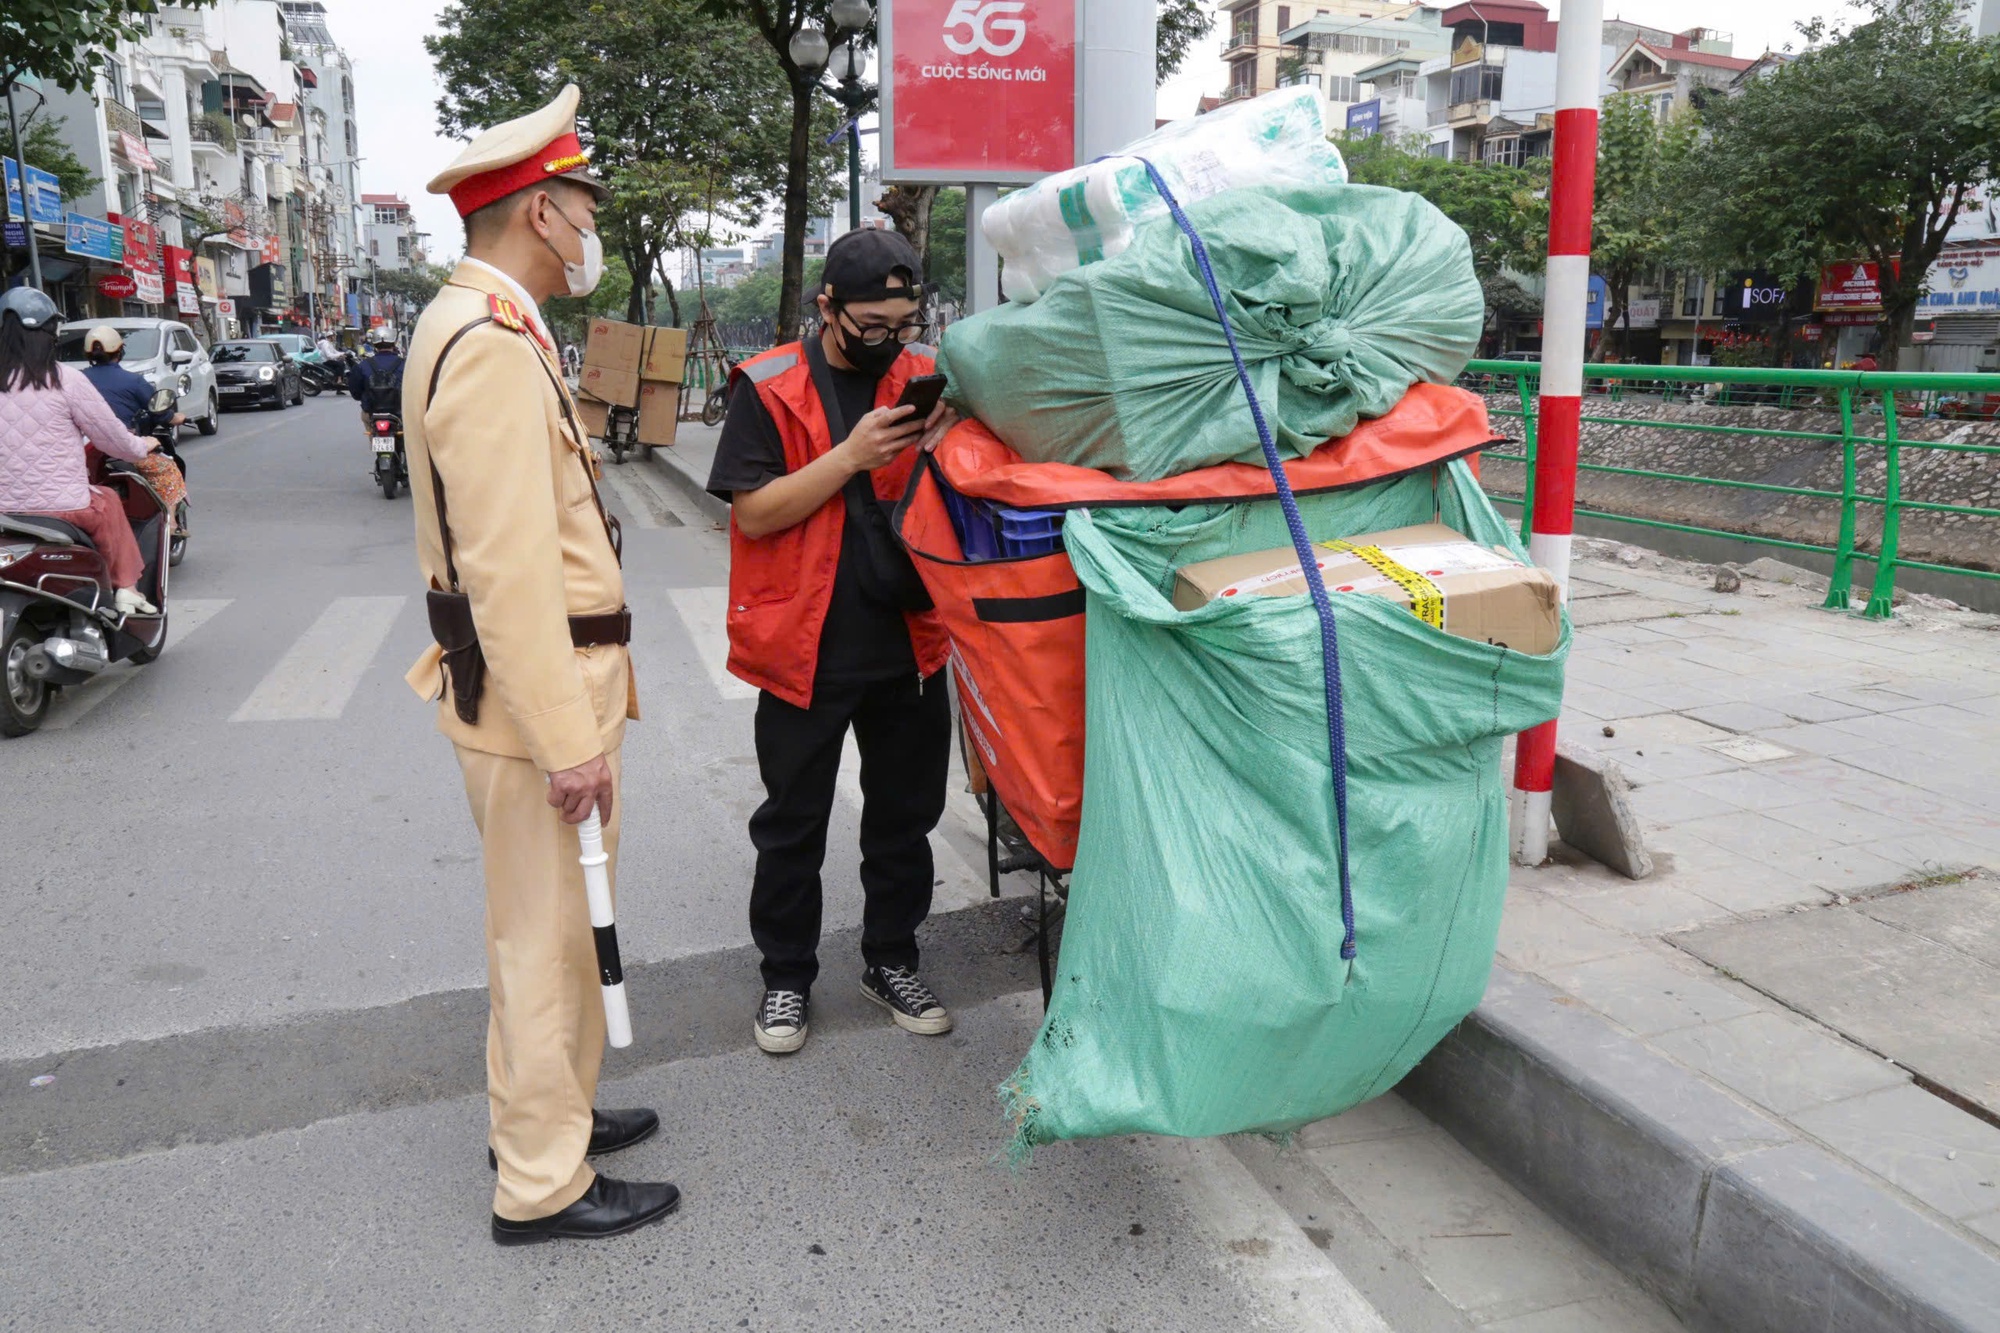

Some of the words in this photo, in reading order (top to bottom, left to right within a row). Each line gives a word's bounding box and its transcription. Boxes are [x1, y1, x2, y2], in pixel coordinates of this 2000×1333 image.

[942, 0, 1026, 56] 5G
[921, 62, 965, 80] CUỘC
[966, 61, 1012, 80] SỐNG
[1015, 66, 1046, 81] MỚI
[98, 280, 135, 294] Triumph
